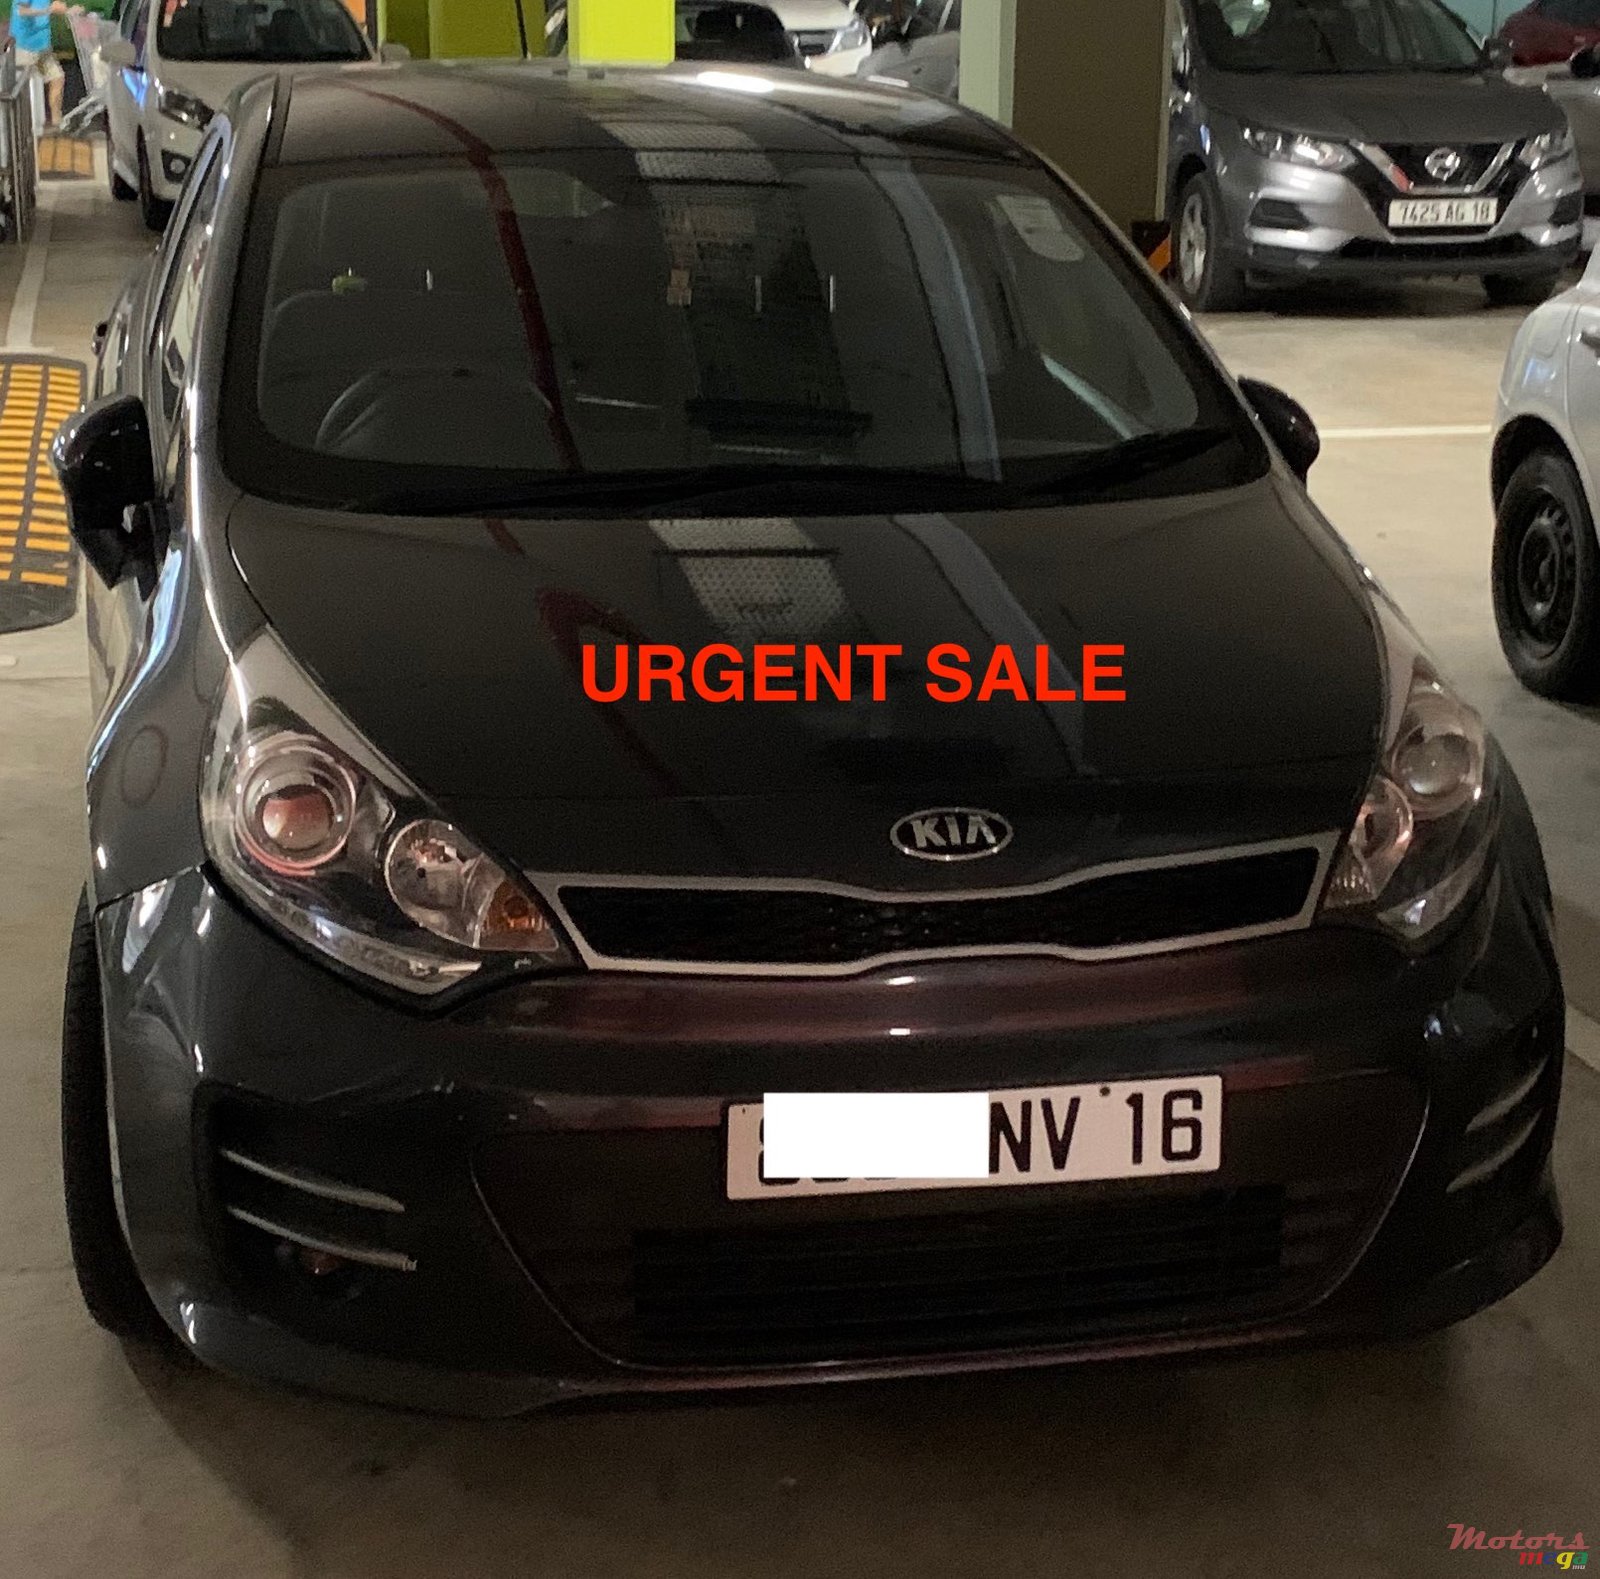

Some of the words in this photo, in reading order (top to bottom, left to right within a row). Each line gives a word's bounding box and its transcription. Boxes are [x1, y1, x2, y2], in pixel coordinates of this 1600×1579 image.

[911, 816, 997, 848] KIA
[989, 1097, 1081, 1174] NV
[1126, 1089, 1203, 1165] 16
